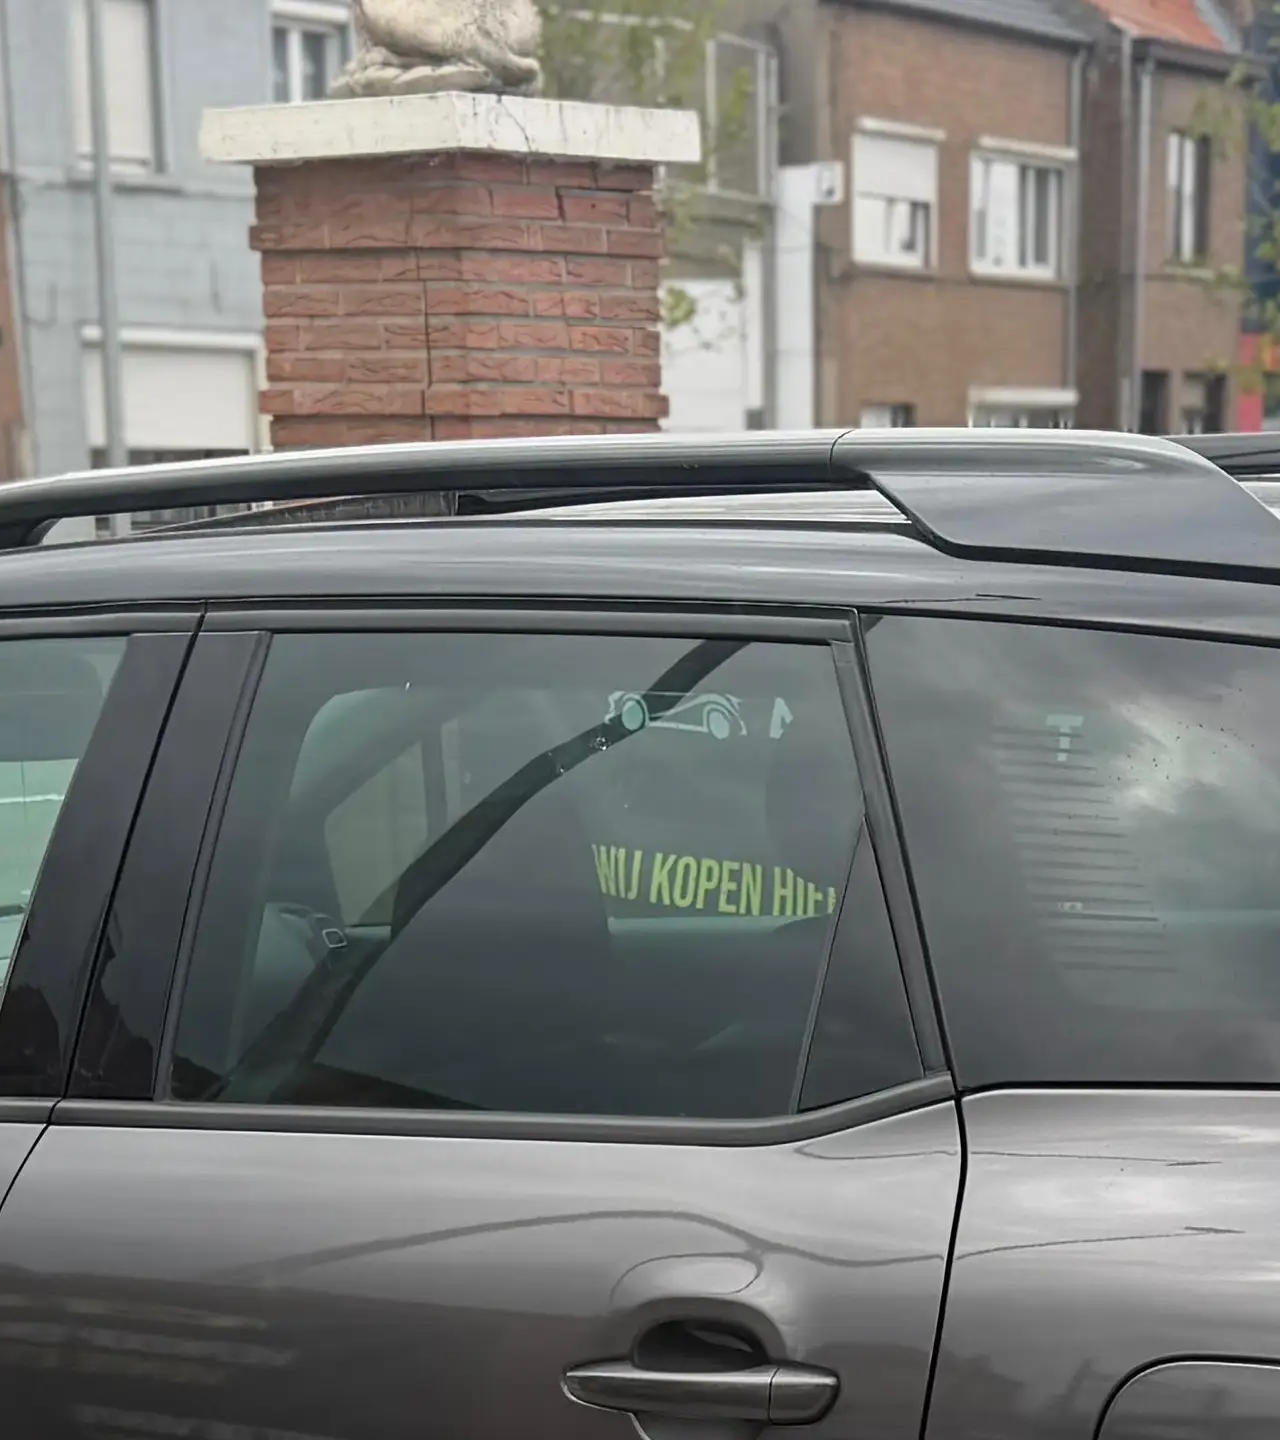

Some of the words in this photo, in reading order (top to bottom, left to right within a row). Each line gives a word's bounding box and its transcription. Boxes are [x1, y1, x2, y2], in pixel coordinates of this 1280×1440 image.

[591, 843, 644, 901] WIJ
[649, 852, 763, 917] KOPEN
[772, 866, 838, 917] HIE
